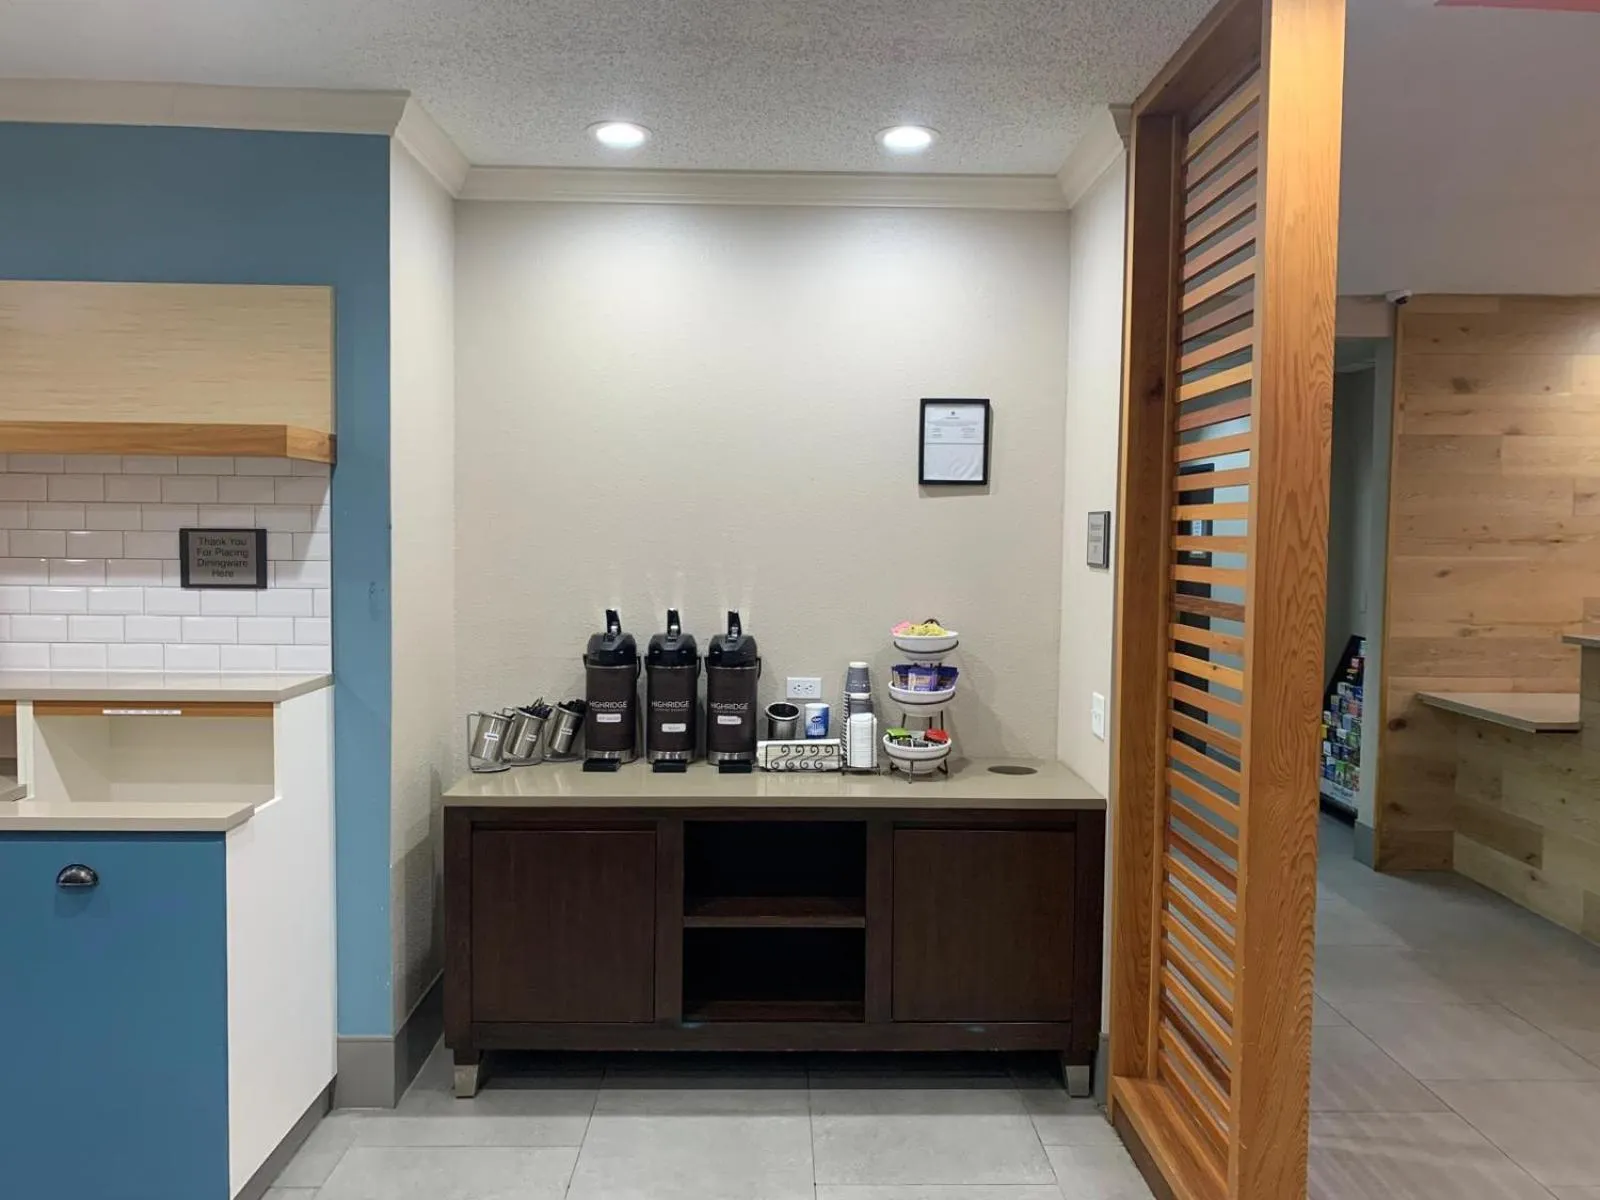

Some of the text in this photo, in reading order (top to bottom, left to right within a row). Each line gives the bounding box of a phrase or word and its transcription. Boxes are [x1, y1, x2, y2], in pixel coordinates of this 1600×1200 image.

[198, 537, 247, 546] Thank You
[197, 548, 249, 558] For Placing
[197, 559, 248, 569] Diningware
[212, 569, 234, 577] Here
